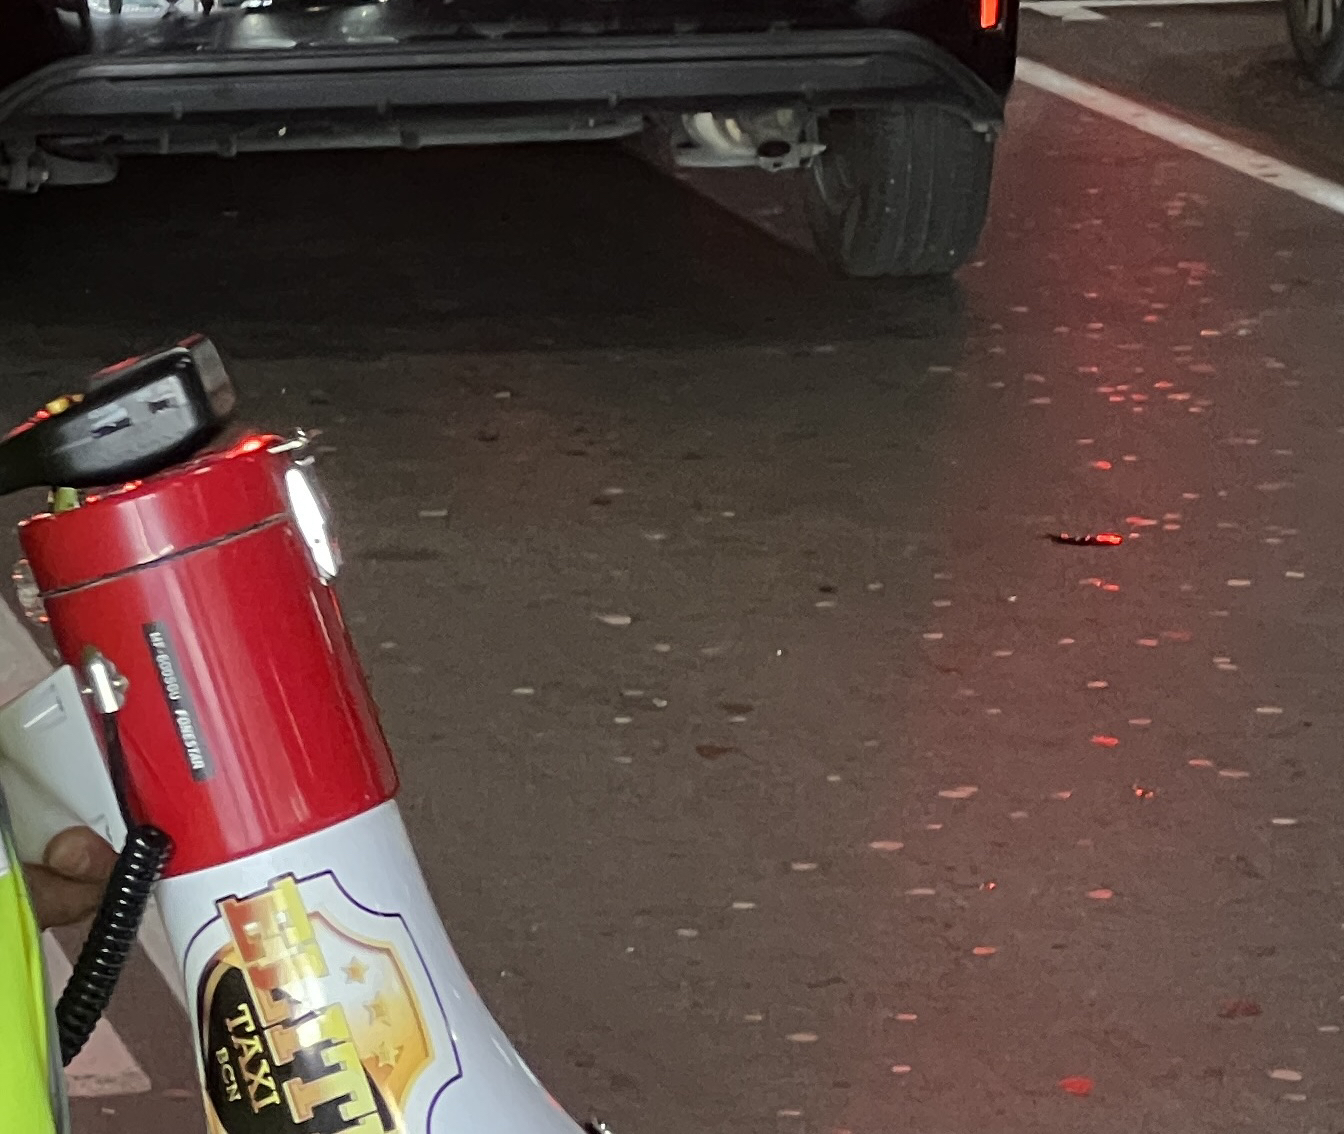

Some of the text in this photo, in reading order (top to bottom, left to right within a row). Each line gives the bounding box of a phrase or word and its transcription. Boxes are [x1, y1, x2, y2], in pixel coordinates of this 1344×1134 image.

[174, 709, 206, 770] FONESTAR
[218, 873, 386, 1134] ELIT
[216, 1047, 242, 1102] BCN
[225, 1003, 281, 1114] TAXI
